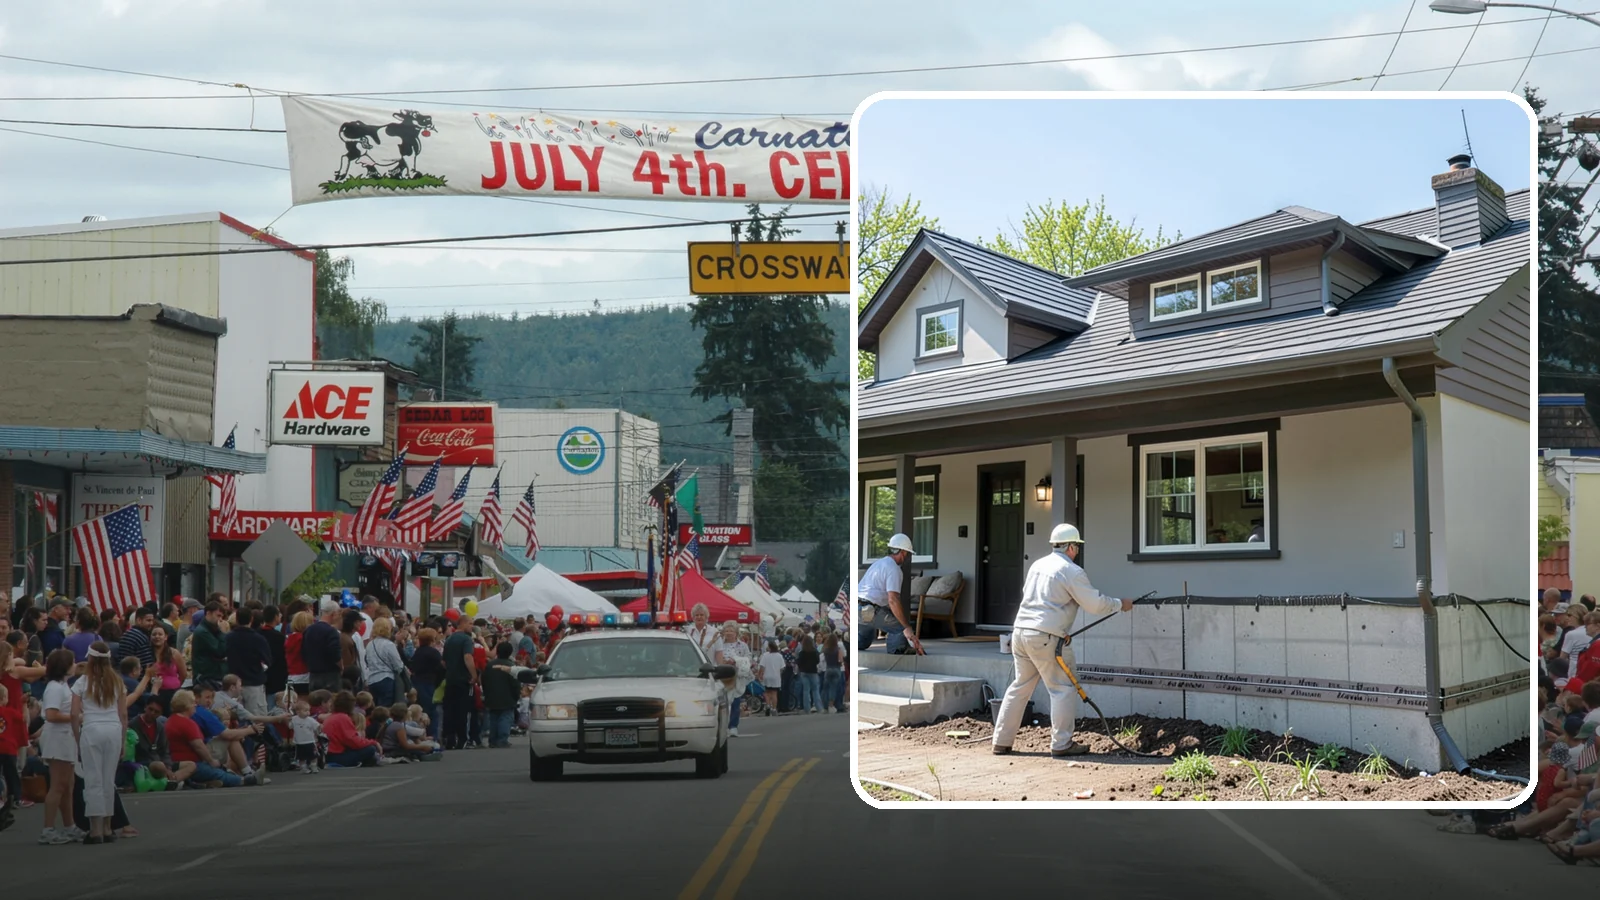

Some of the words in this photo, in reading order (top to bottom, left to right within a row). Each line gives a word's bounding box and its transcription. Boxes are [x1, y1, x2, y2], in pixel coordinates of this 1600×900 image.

[481, 141, 605, 192] JULY
[632, 150, 746, 198] 4th.
[697, 254, 850, 280] CROSSWA
[282, 380, 373, 420] ACE
[405, 409, 452, 422] CEDAR
[283, 421, 371, 436] Hardware
[416, 428, 477, 447] Coca-Cola
[353, 467, 385, 481] Simpl
[95, 485, 124, 494] Vincent
[126, 485, 135, 494] de
[137, 486, 155, 495] Paul
[212, 516, 330, 535] HARDARE
[688, 526, 742, 535] CRNATION
